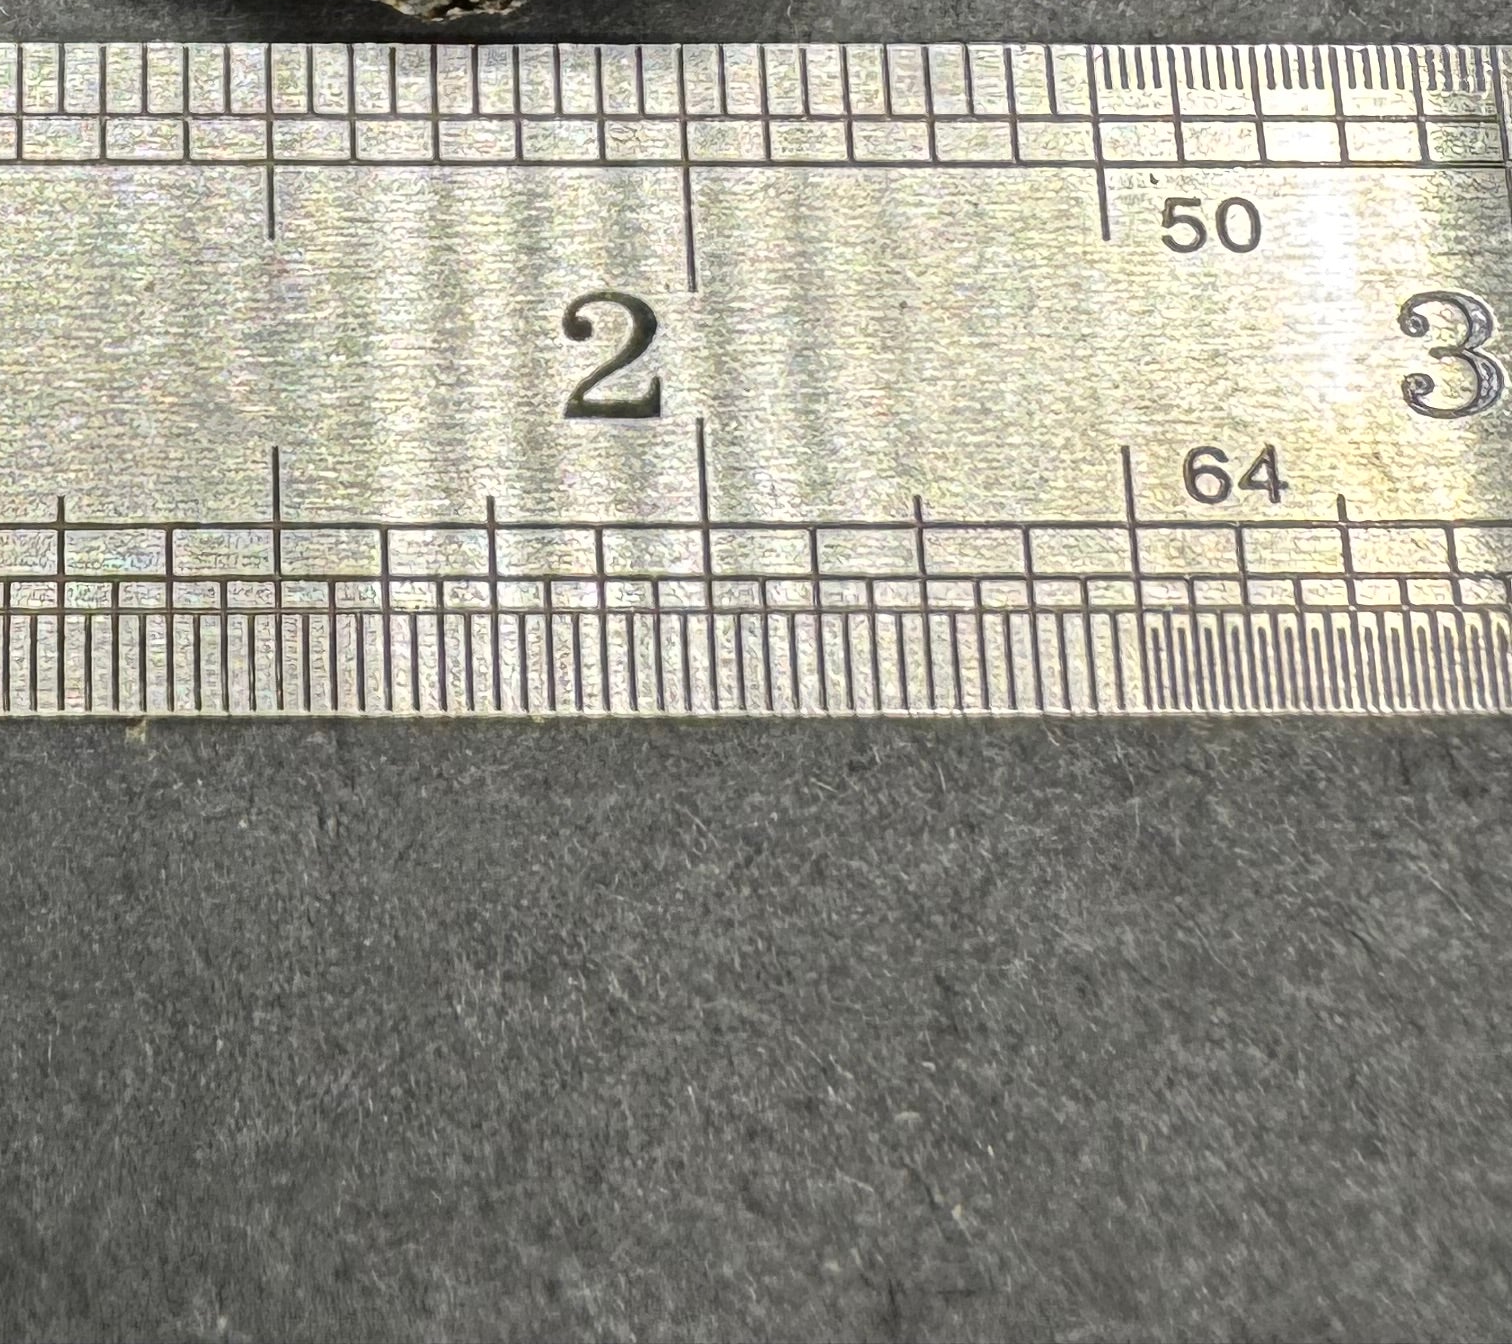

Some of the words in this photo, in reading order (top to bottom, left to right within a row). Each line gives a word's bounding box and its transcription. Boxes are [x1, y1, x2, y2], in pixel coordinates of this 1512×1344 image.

[1160, 197, 1262, 254] 50
[562, 292, 661, 419] 2
[1399, 291, 1505, 419] 3
[1183, 445, 1288, 504] 64
